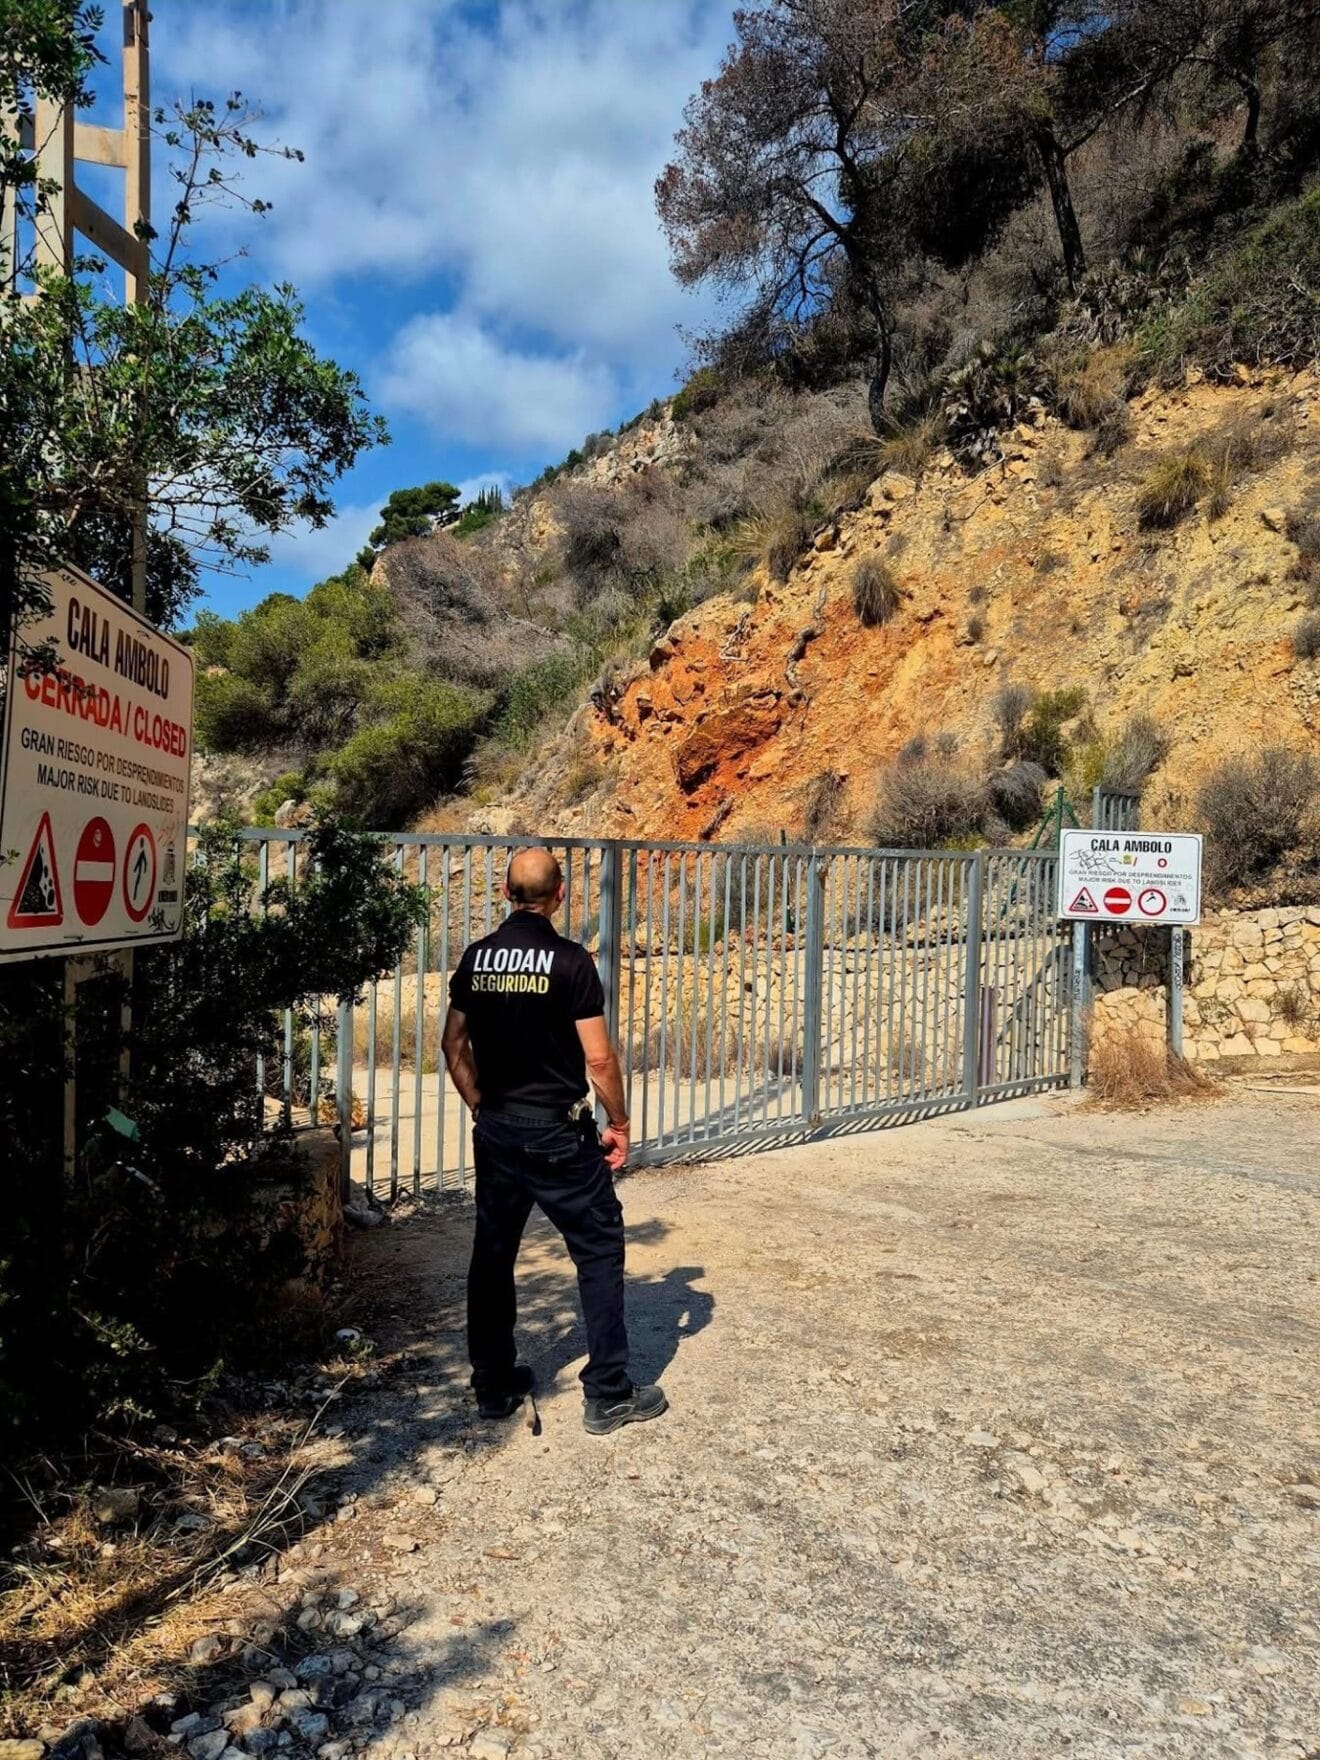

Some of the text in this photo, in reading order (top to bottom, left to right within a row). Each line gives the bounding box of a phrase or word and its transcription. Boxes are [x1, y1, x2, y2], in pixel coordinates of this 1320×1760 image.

[67, 597, 169, 700] CALA AMBOLO
[24, 656, 122, 734] CERRADA
[134, 705, 187, 758] CLOSED
[21, 727, 184, 794] GRAN RIESGO POR DESPRENDIMIENTOS
[37, 763, 174, 814] MAJOR RISK DUE TO LANDSLIDES
[1091, 839, 1172, 854] CALA AMBOLO
[471, 974, 550, 994] SEGURIDAD
[473, 948, 555, 975] LLODAN
